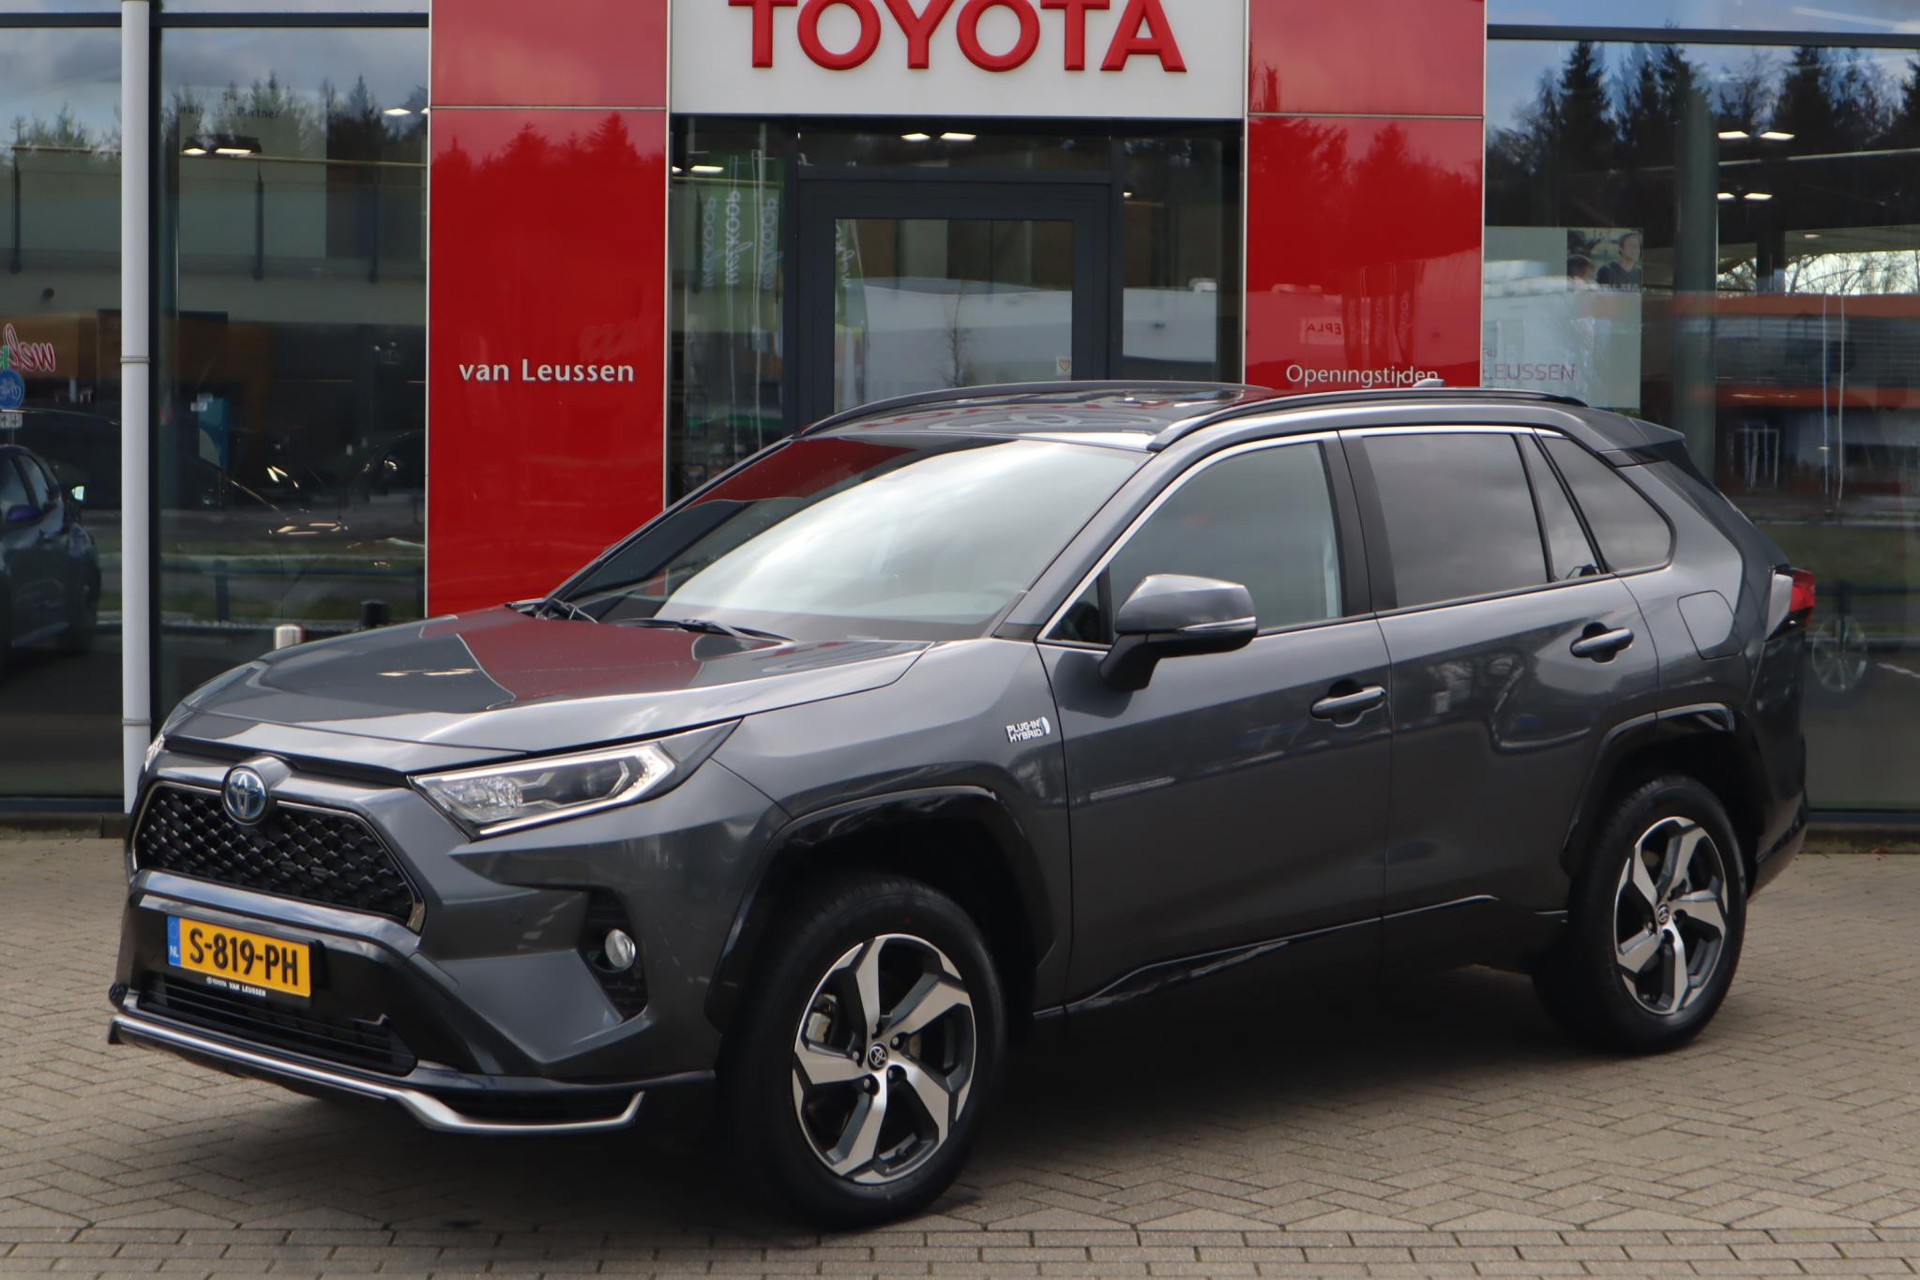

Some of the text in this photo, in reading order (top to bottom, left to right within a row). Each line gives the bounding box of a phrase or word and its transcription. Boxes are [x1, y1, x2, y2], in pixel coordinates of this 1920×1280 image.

[728, 0, 1187, 73] TOYOTA
[458, 358, 635, 382] van Leussen
[1285, 363, 1439, 389] Openingstijden
[1006, 718, 1041, 733] PLUG-IN
[1009, 728, 1044, 743] HYBRID
[169, 927, 299, 987] NL S-819-PH
[229, 981, 241, 991] VAN
